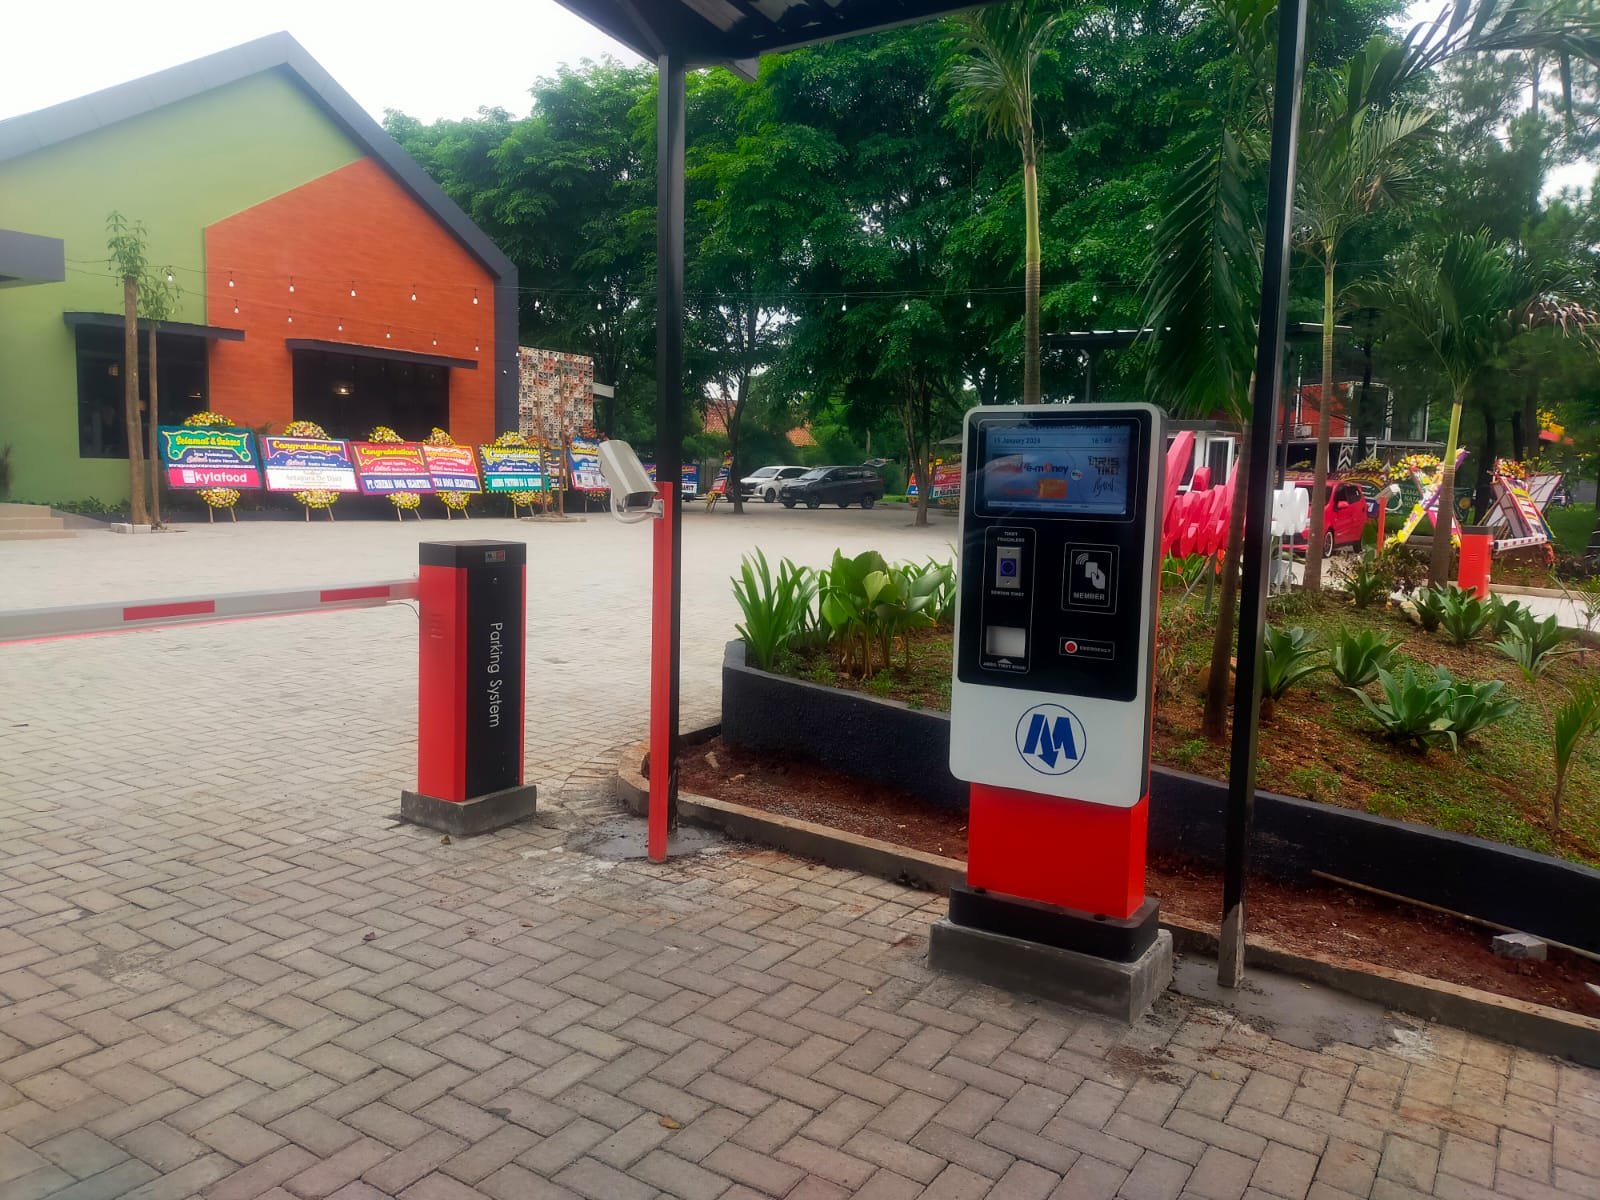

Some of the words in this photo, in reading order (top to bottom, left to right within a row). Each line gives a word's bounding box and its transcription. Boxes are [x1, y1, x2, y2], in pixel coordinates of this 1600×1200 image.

[272, 440, 342, 452] Congratulations
[361, 447, 418, 458] Congratulations
[194, 471, 248, 485] kylafood
[1073, 591, 1106, 601] MEMBER
[487, 622, 503, 674] Parking
[487, 679, 503, 728] System
